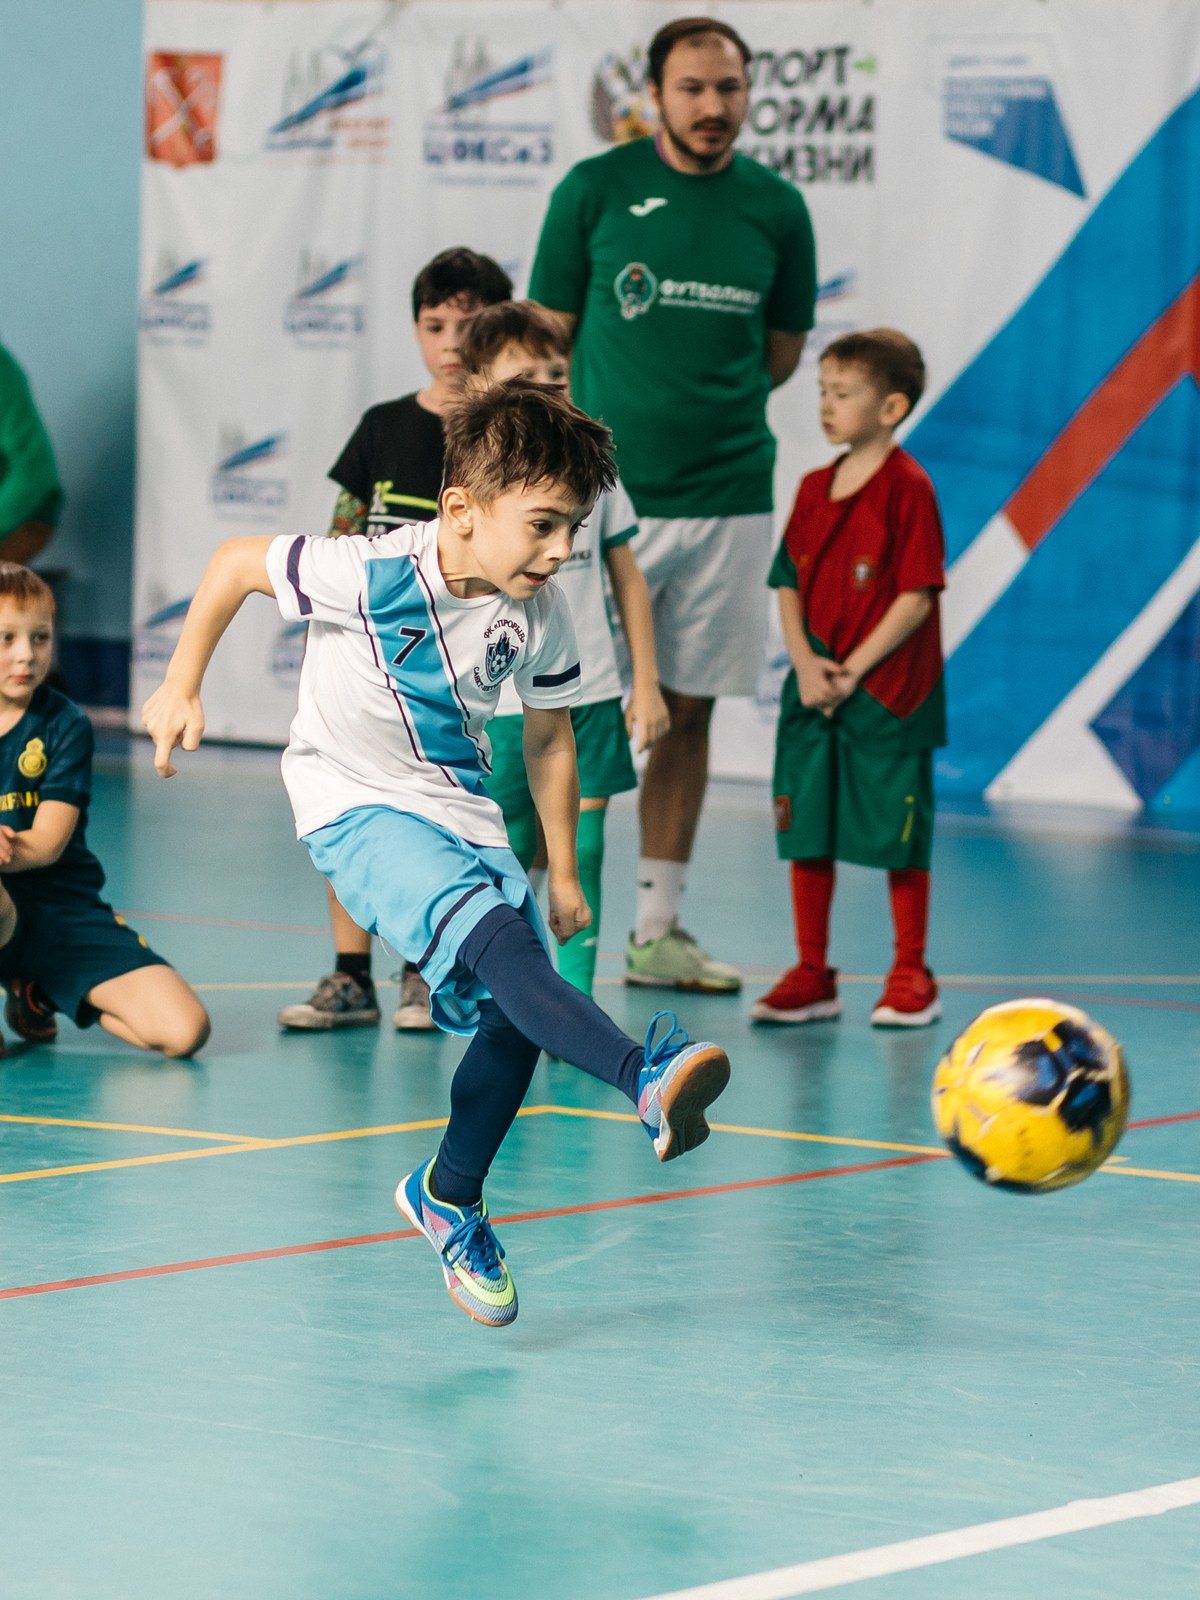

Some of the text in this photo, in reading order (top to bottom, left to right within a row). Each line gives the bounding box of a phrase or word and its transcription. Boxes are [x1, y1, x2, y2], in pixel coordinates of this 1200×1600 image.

[746, 45, 850, 88] ПОРТ
[748, 95, 875, 136] ОРМА
[391, 626, 428, 667] 7
